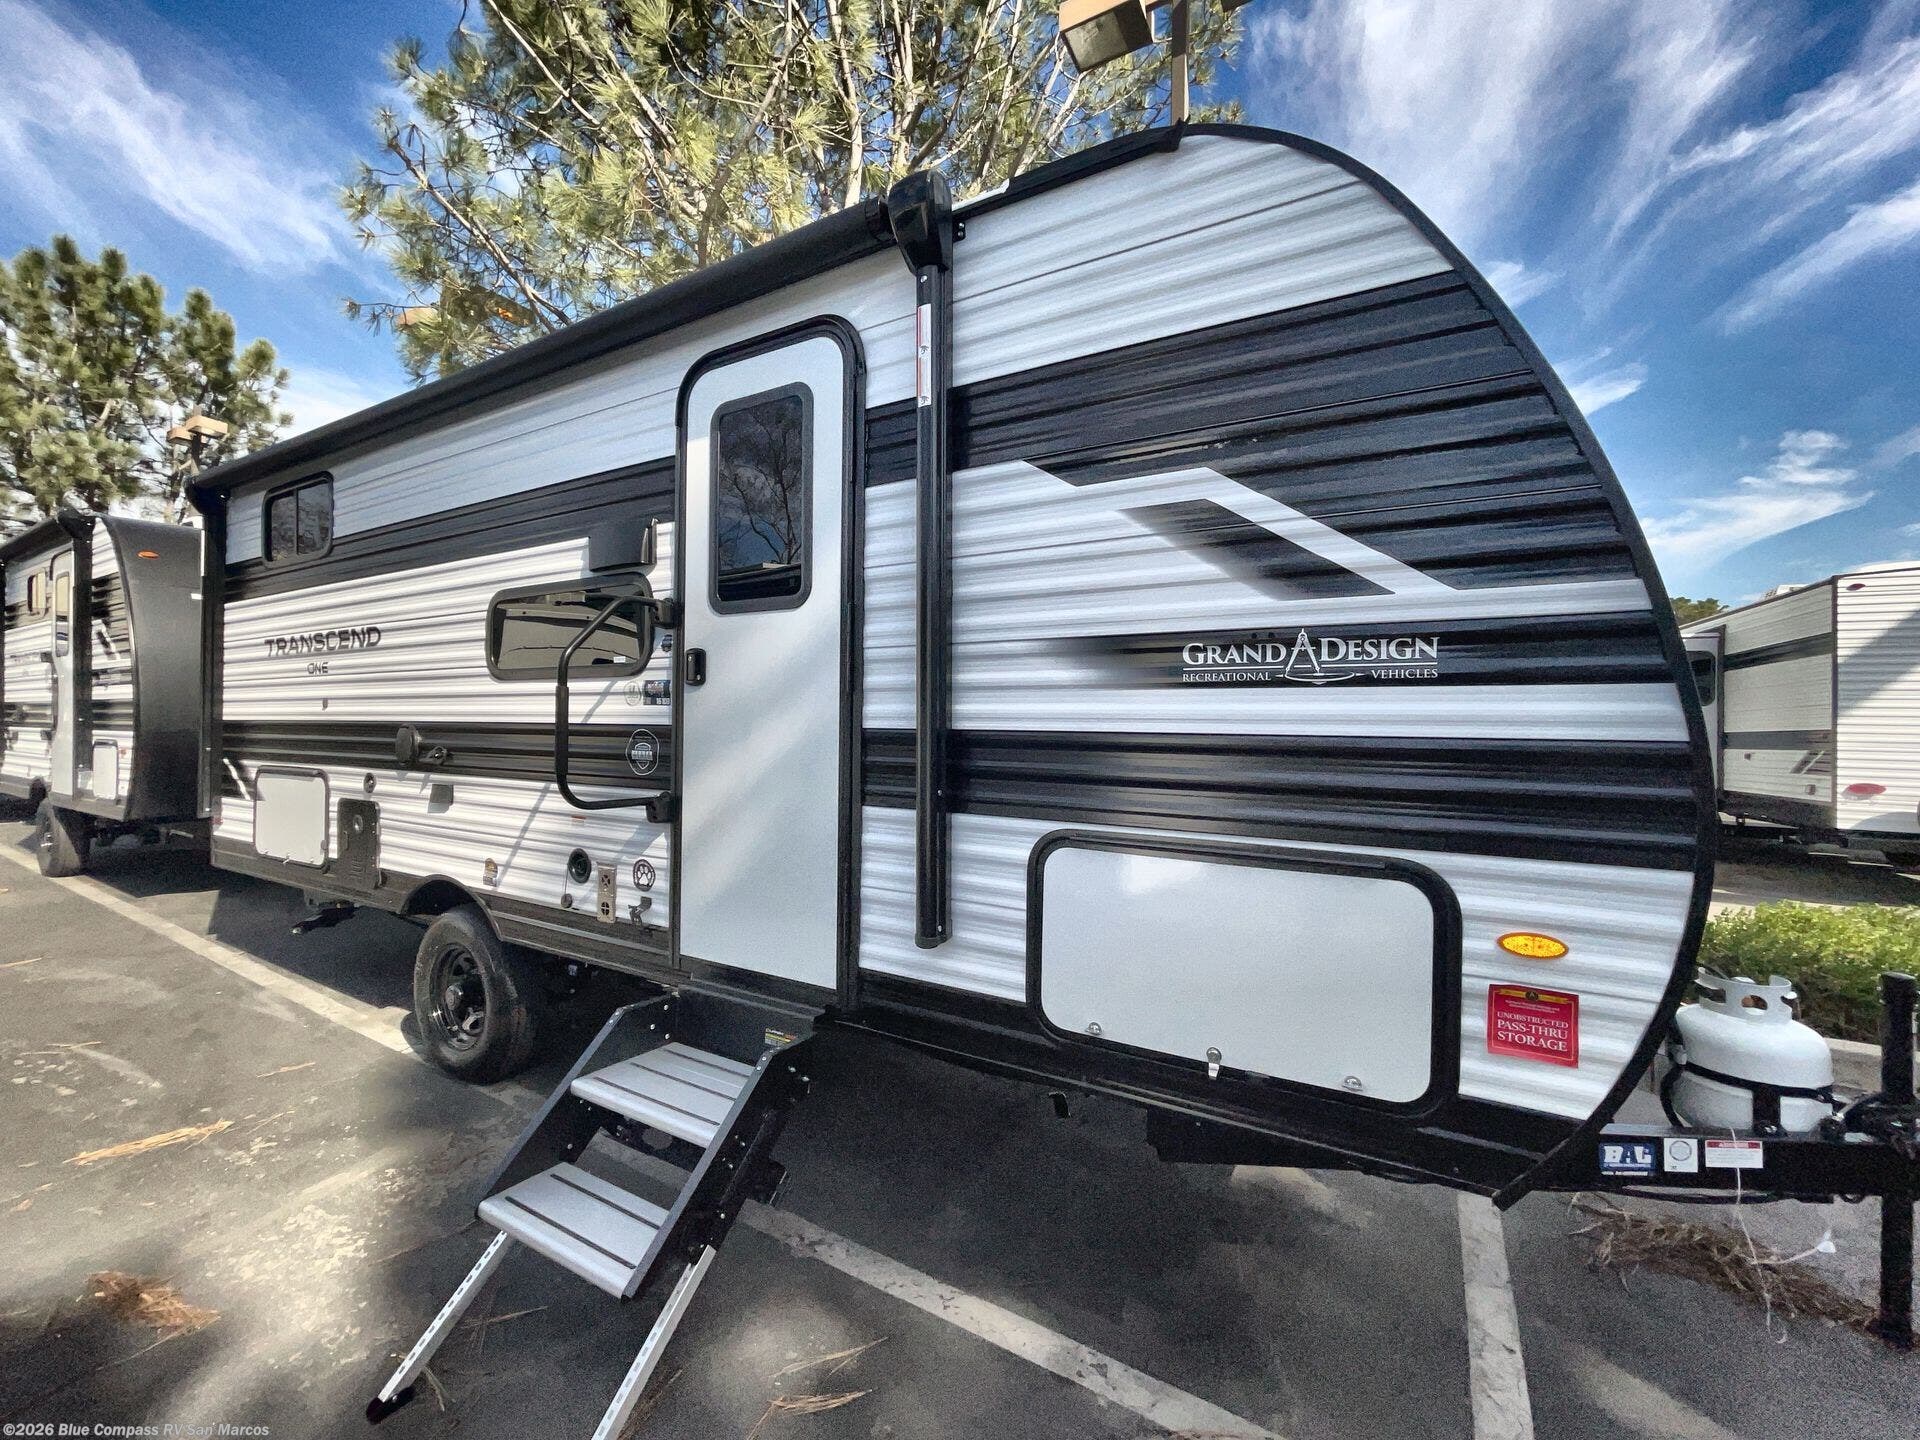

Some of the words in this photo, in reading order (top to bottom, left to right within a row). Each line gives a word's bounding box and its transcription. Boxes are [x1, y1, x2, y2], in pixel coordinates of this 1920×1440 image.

[264, 626, 382, 657] TRANSCEND
[1182, 642, 1287, 665] GRAND
[1318, 636, 1440, 662] DESIGN
[307, 661, 329, 675] ONE
[1182, 671, 1272, 683] RECREATIONAL
[1371, 668, 1439, 680] VEHICLES
[1497, 1011, 1569, 1029] UNOBSTRUCTED
[1497, 1018, 1568, 1040] PASS-THRU
[1497, 1030, 1568, 1052] STORAGE
